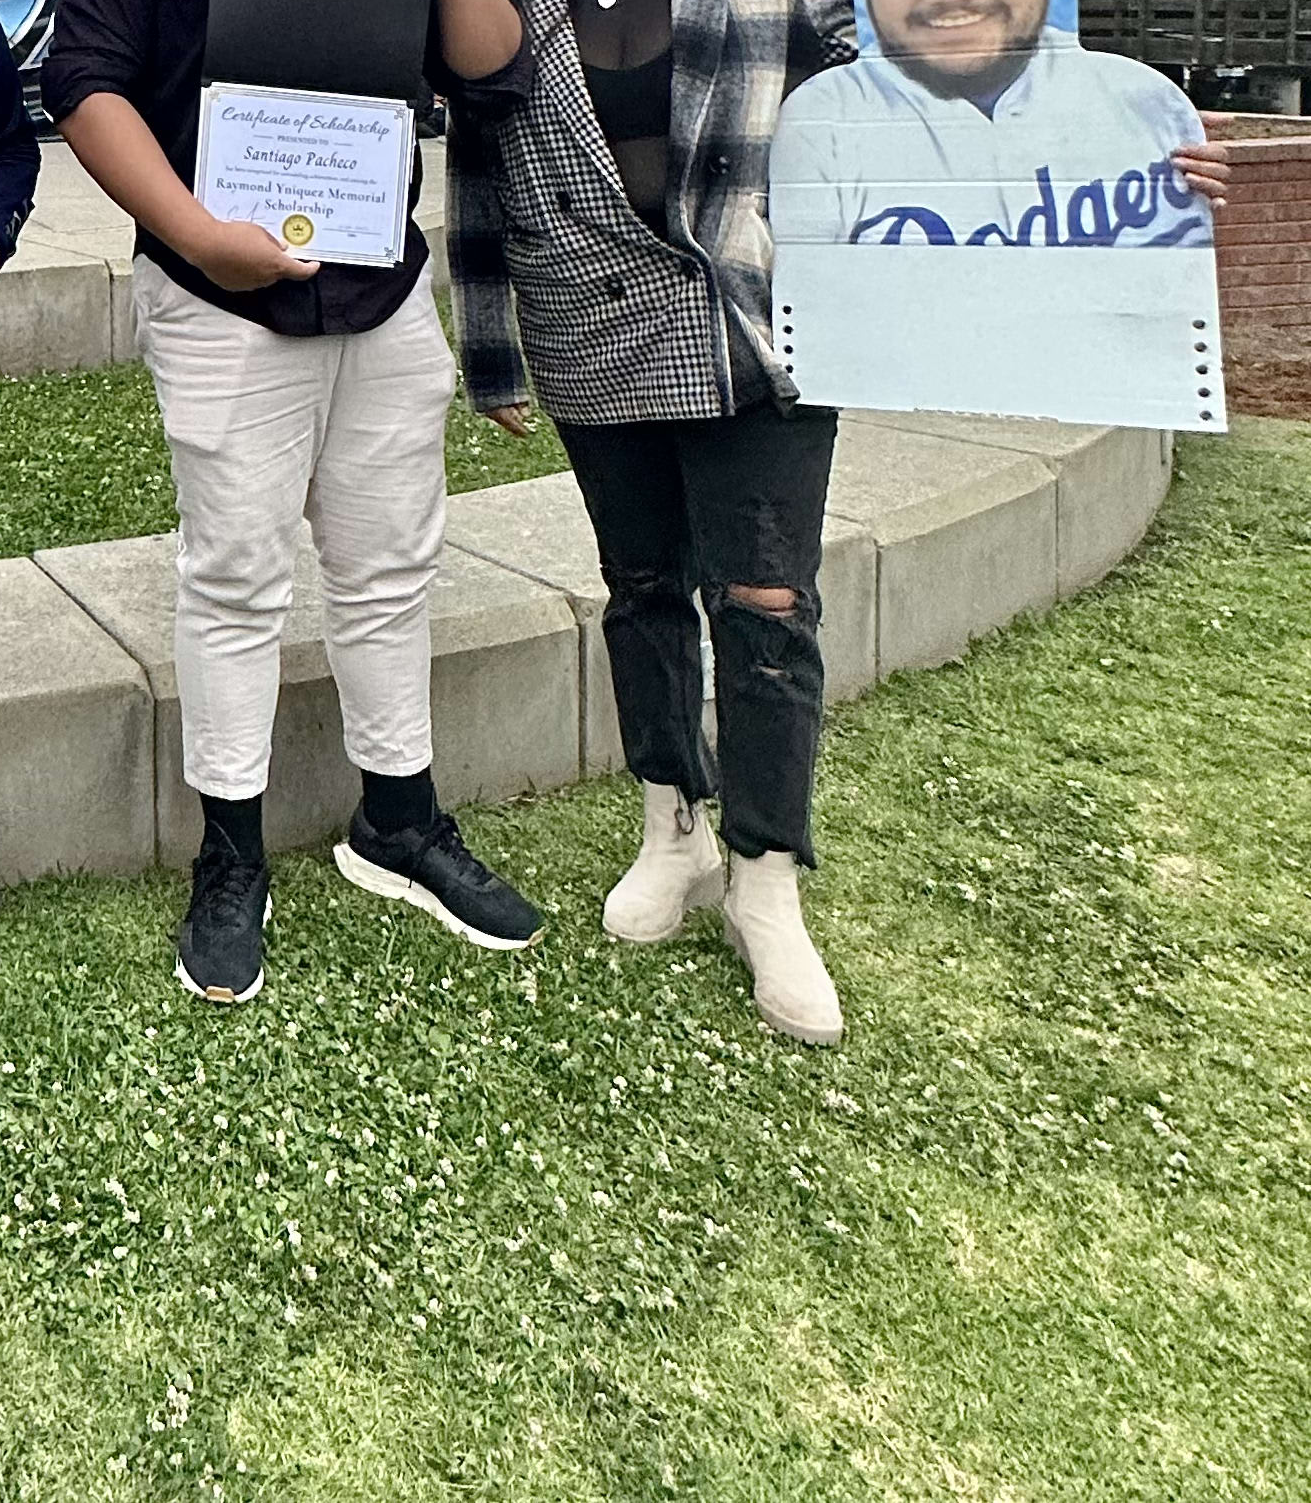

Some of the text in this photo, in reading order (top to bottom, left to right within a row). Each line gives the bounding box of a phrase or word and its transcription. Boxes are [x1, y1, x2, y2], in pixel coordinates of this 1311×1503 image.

[222, 106, 389, 142] Certificate of Scholarship
[243, 145, 357, 170] Santiago Pacheco
[216, 178, 386, 204] Raymond Yniquez Memorial
[264, 198, 334, 218] Scholarship
